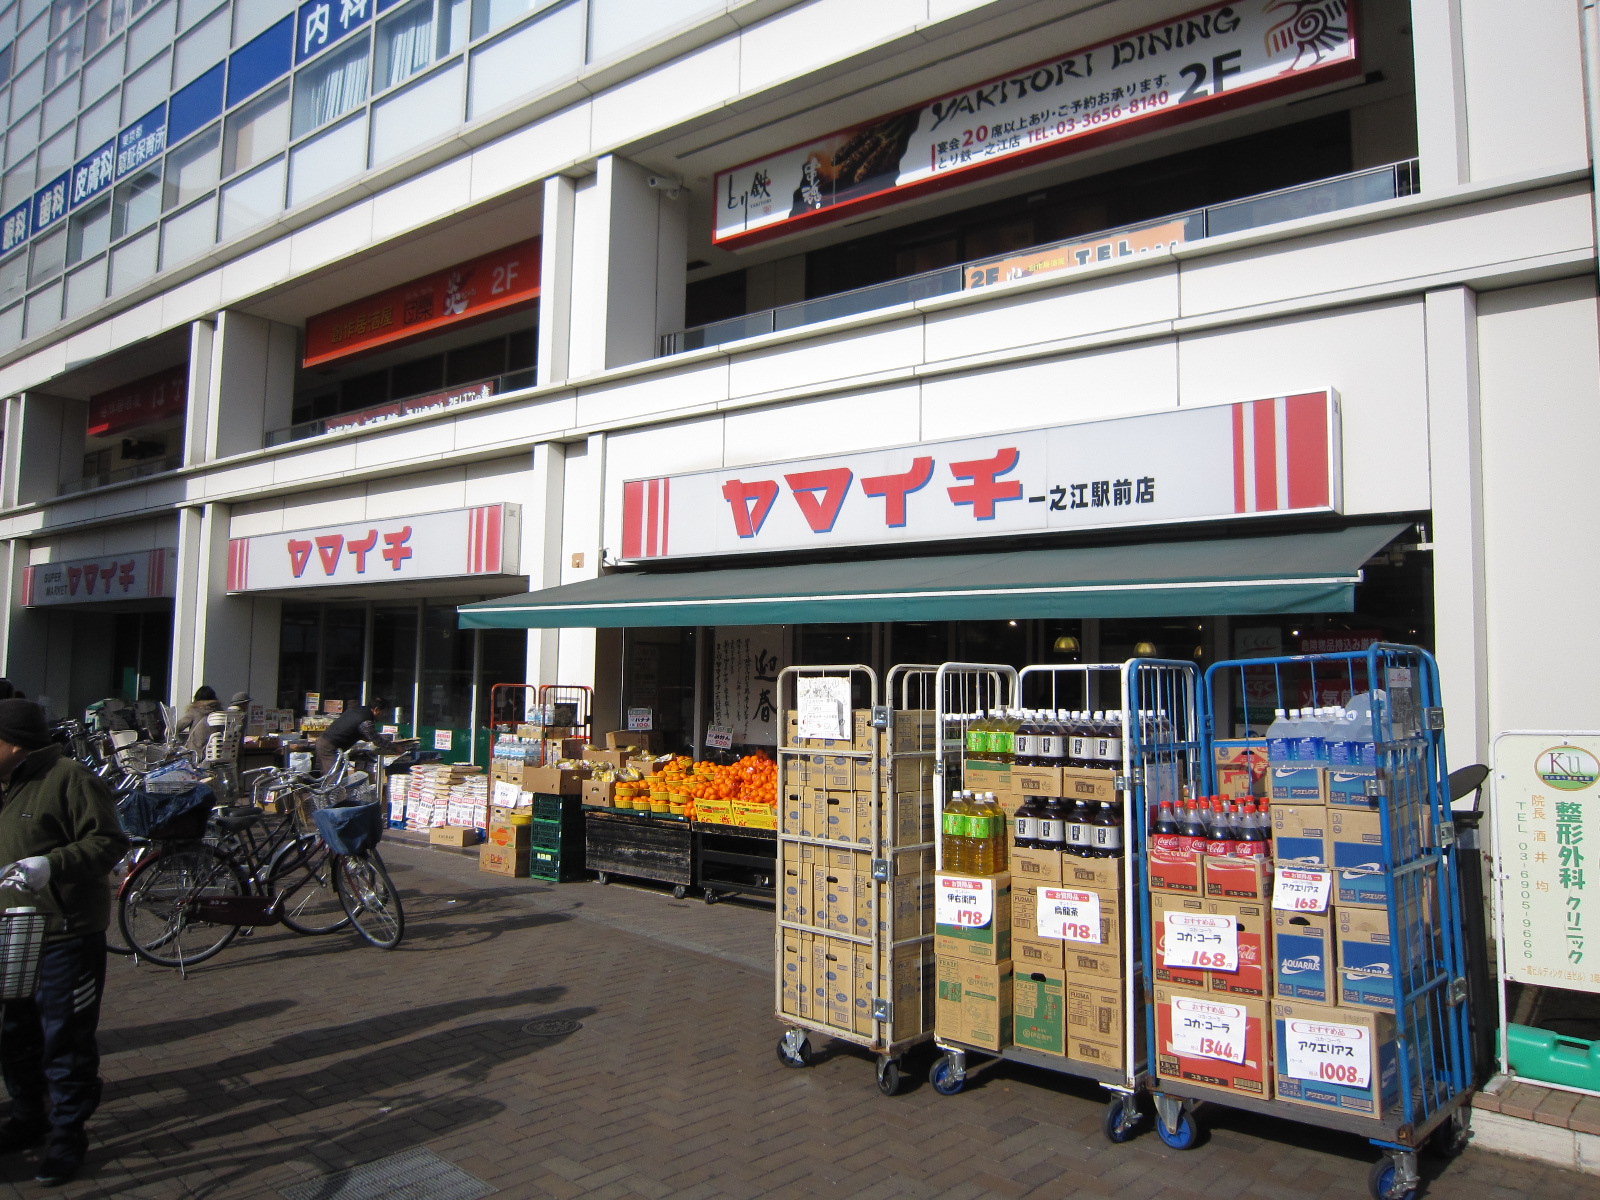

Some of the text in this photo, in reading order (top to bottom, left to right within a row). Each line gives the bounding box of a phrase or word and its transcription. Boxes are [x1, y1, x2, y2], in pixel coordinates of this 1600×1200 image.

[303, 0, 367, 53] 内科
[930, 7, 1241, 131] YAKITORI DINING
[1178, 49, 1242, 105] 2F
[1027, 90, 1170, 145] TEL:03-3656-8140
[123, 124, 143, 148] 東京都
[118, 124, 166, 176] 認証保育所
[74, 146, 113, 203] 皮膚科
[39, 181, 65, 227] 歯科
[491, 262, 520, 294] 2F
[722, 447, 1156, 539] ヤマイチ 一之江駅前店
[288, 526, 412, 578] ヤマイチ
[44, 572, 62, 583] SUPER
[68, 560, 136, 596] ヤマイチ
[46, 585, 68, 596] MARKET
[753, 649, 778, 723] 迎春
[1548, 753, 1585, 777] Ku
[1531, 795, 1546, 820] 院長
[491, 853, 502, 863] Dole
[1282, 883, 1319, 893] アクエリアス
[1515, 802, 1533, 959] TEL 03-6905-9666
[1055, 906, 1078, 916] 烏龍茶
[1295, 898, 1318, 909] 168
[958, 910, 982, 925] 178
[1184, 917, 1216, 926] おすすめ品
[1062, 922, 1090, 939] 178
[1177, 932, 1222, 944] コカ・コーラ
[1191, 951, 1226, 967] 168
[1282, 957, 1320, 971] AQUARIUS
[1192, 1004, 1225, 1014] おすすめ品
[1184, 1018, 1230, 1033] コカ・コーラ
[1309, 1025, 1346, 1037] おすすめ品
[1200, 1037, 1233, 1058] 1344
[1298, 1041, 1354, 1057] アクエリアス
[1320, 1062, 1357, 1083] 1008
[1306, 1091, 1336, 1102] アクエリアス
